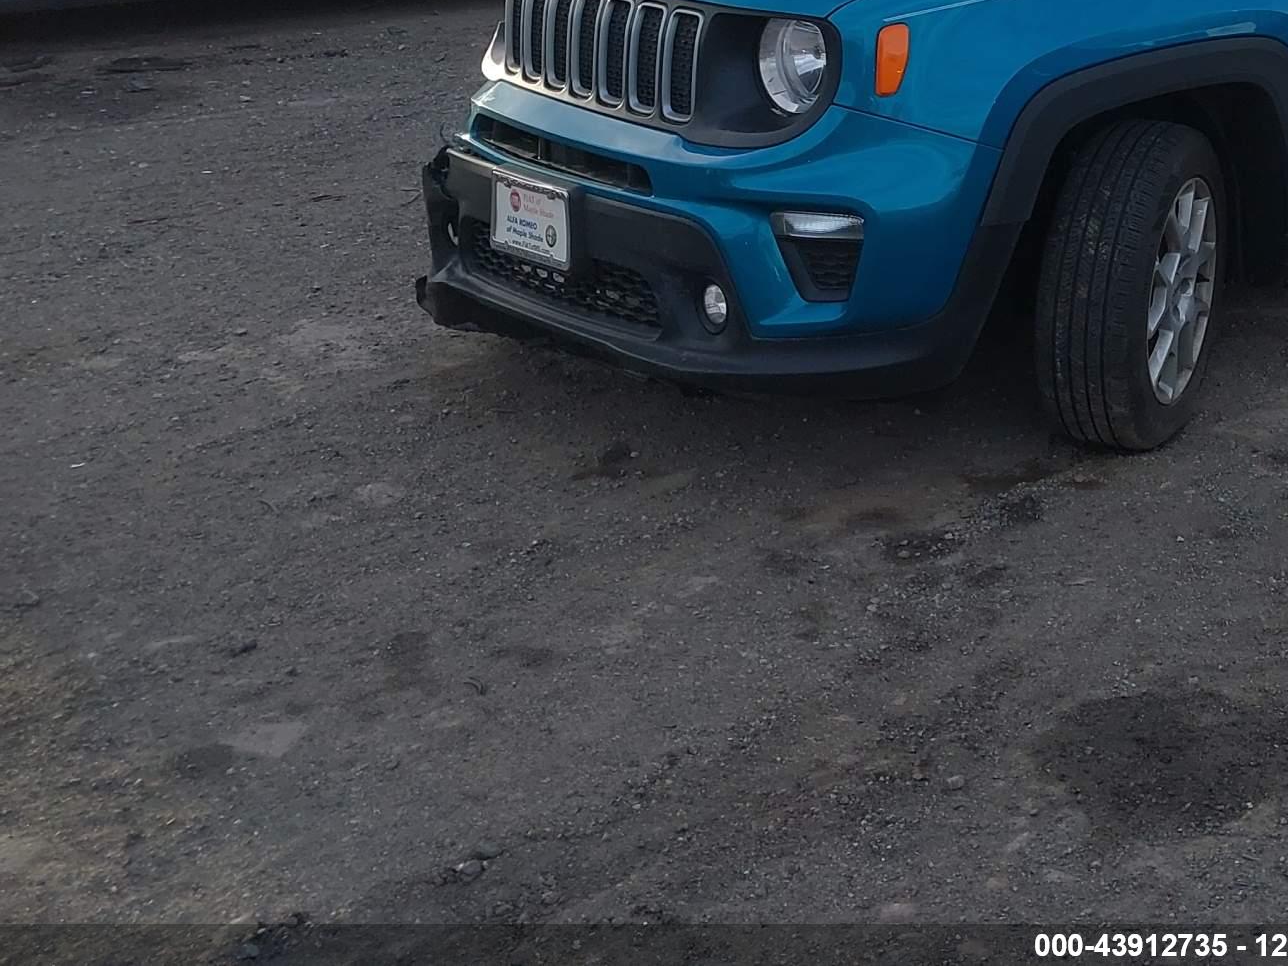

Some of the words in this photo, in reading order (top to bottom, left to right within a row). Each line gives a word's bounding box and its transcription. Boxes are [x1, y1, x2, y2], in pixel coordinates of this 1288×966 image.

[507, 215, 518, 225] ALFA
[519, 218, 538, 230] ROMEO
[512, 227, 527, 238] Maple
[528, 230, 544, 242] Shade
